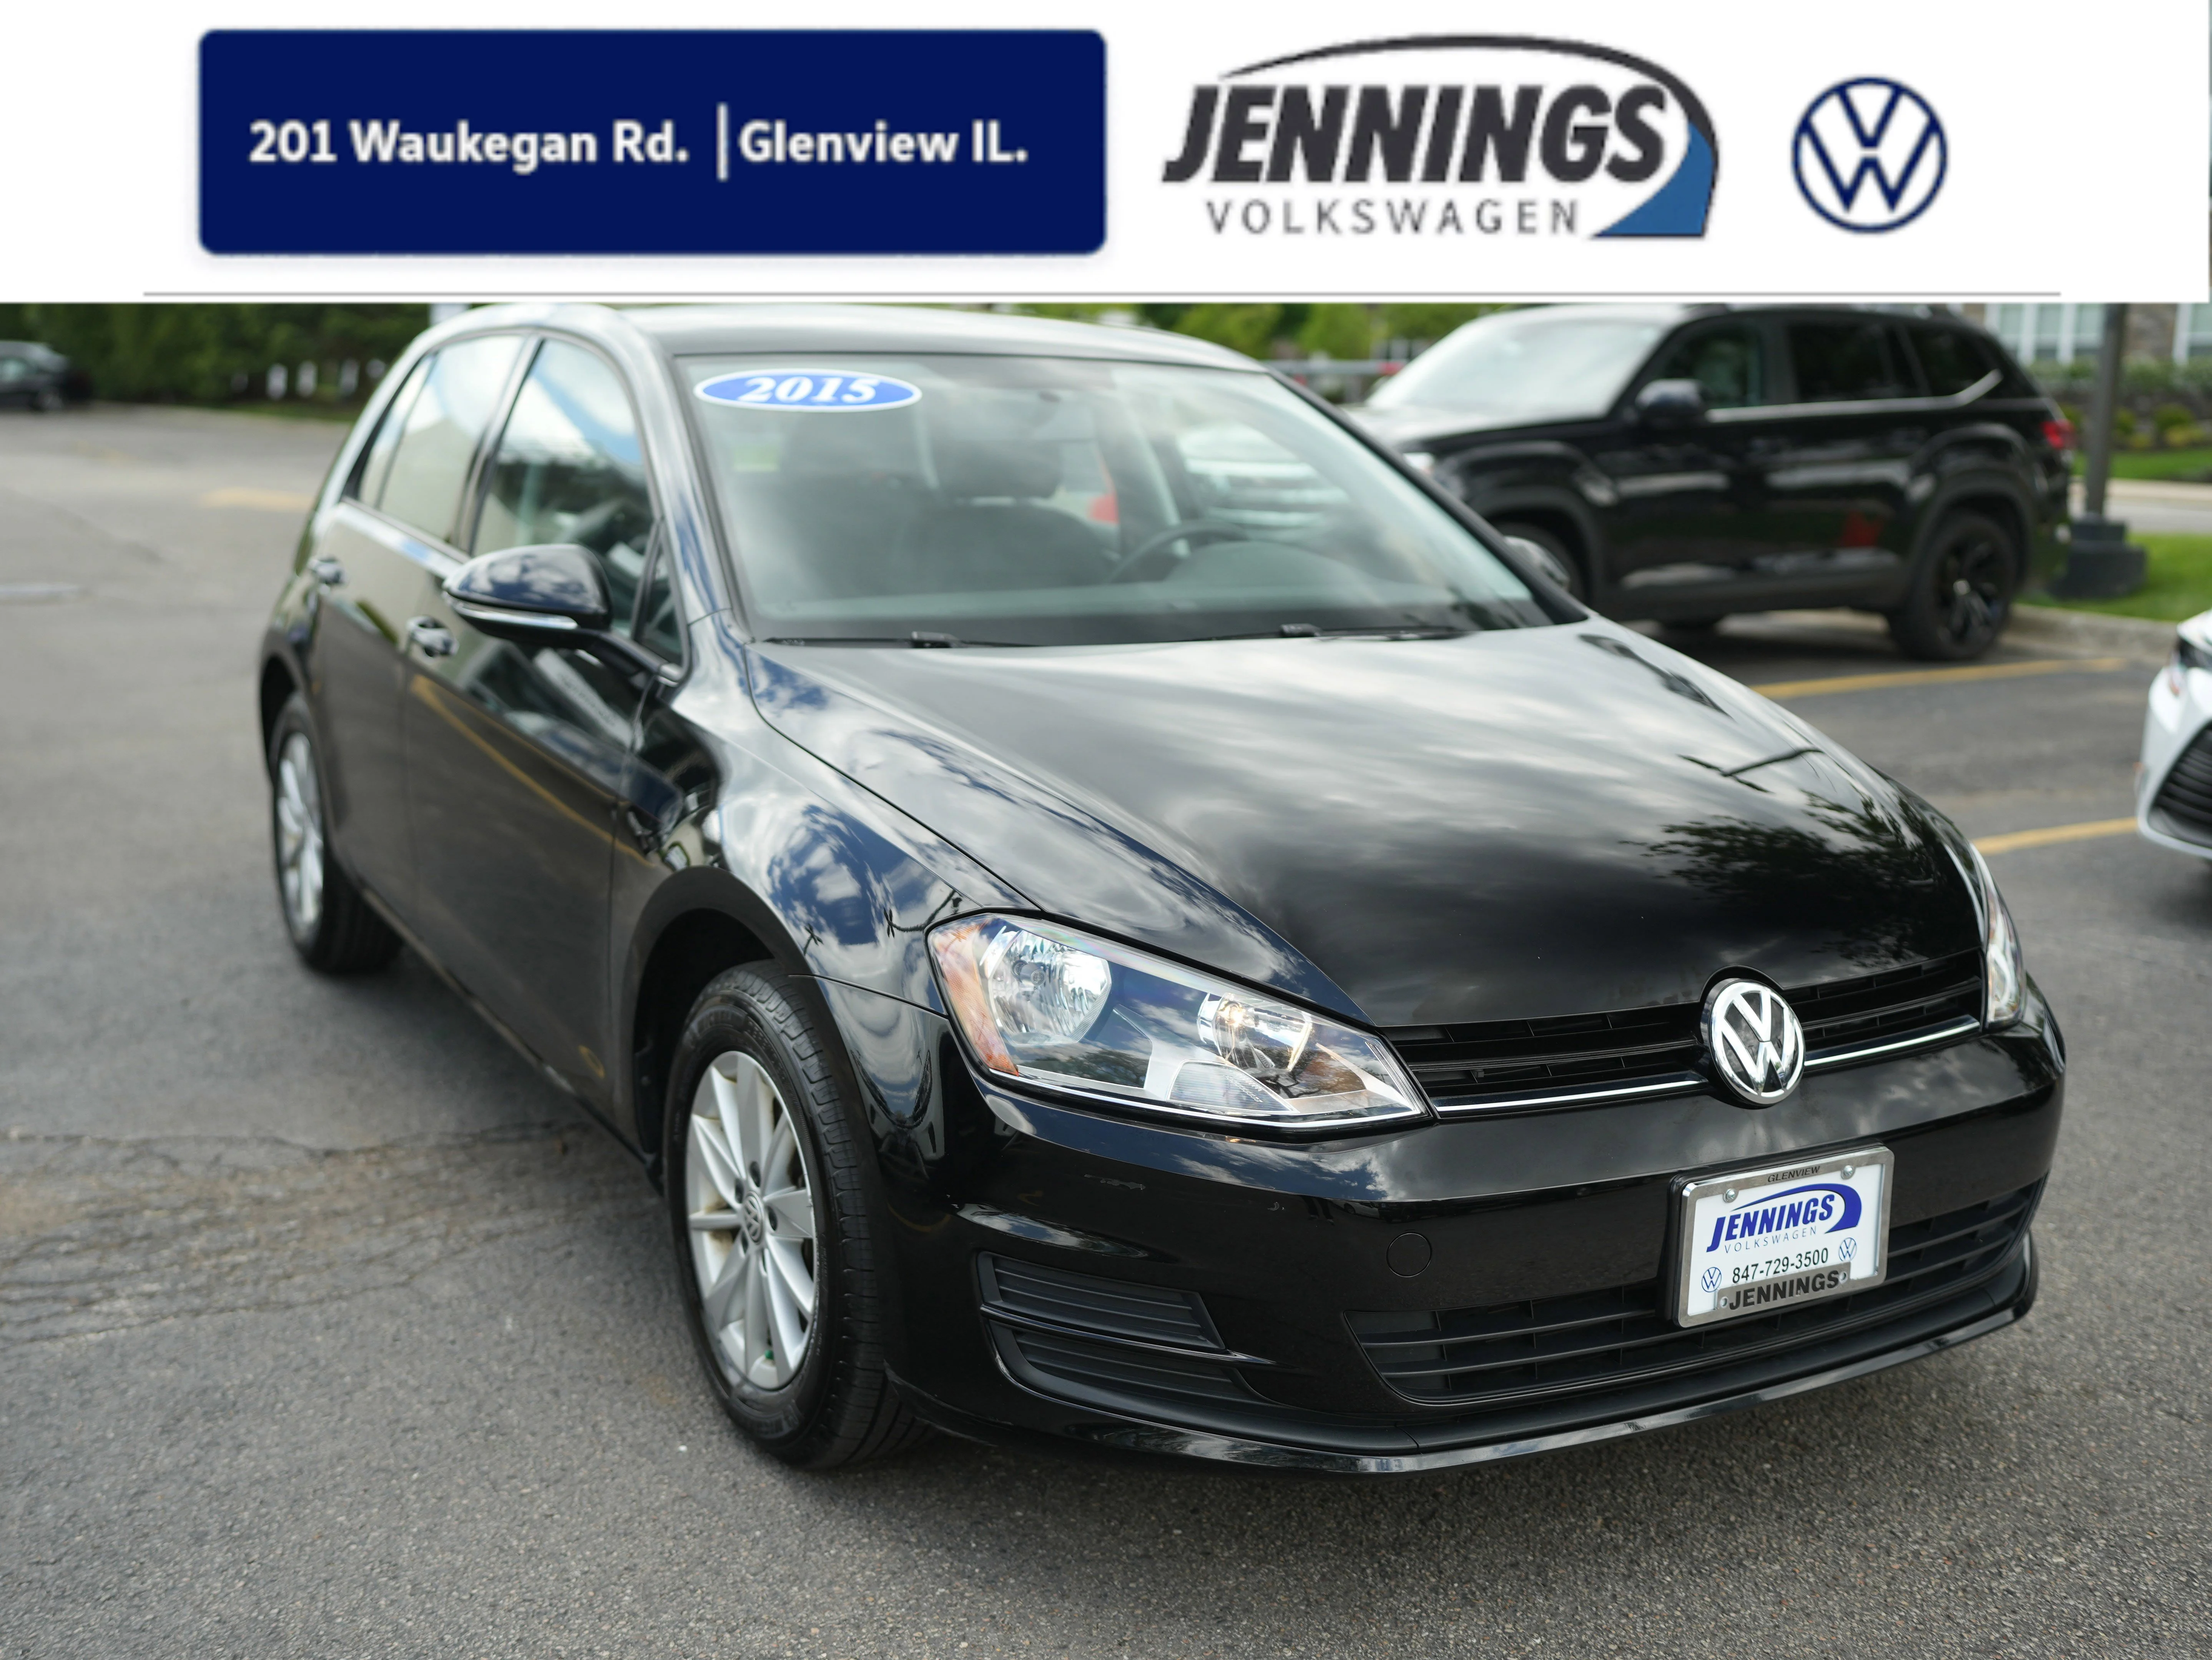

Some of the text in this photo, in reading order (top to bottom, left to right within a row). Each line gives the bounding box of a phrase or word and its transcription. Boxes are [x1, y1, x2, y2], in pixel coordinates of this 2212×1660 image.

[737, 376, 881, 403] 2015
[1768, 1166, 1820, 1182] GLENVIEW
[1706, 1194, 1835, 1253] JENNINGS
[1725, 1226, 1816, 1254] VOLKSWAGEN
[1732, 1247, 1828, 1283] 847-729-3500
[1729, 1270, 1840, 1310] JENNINGS
